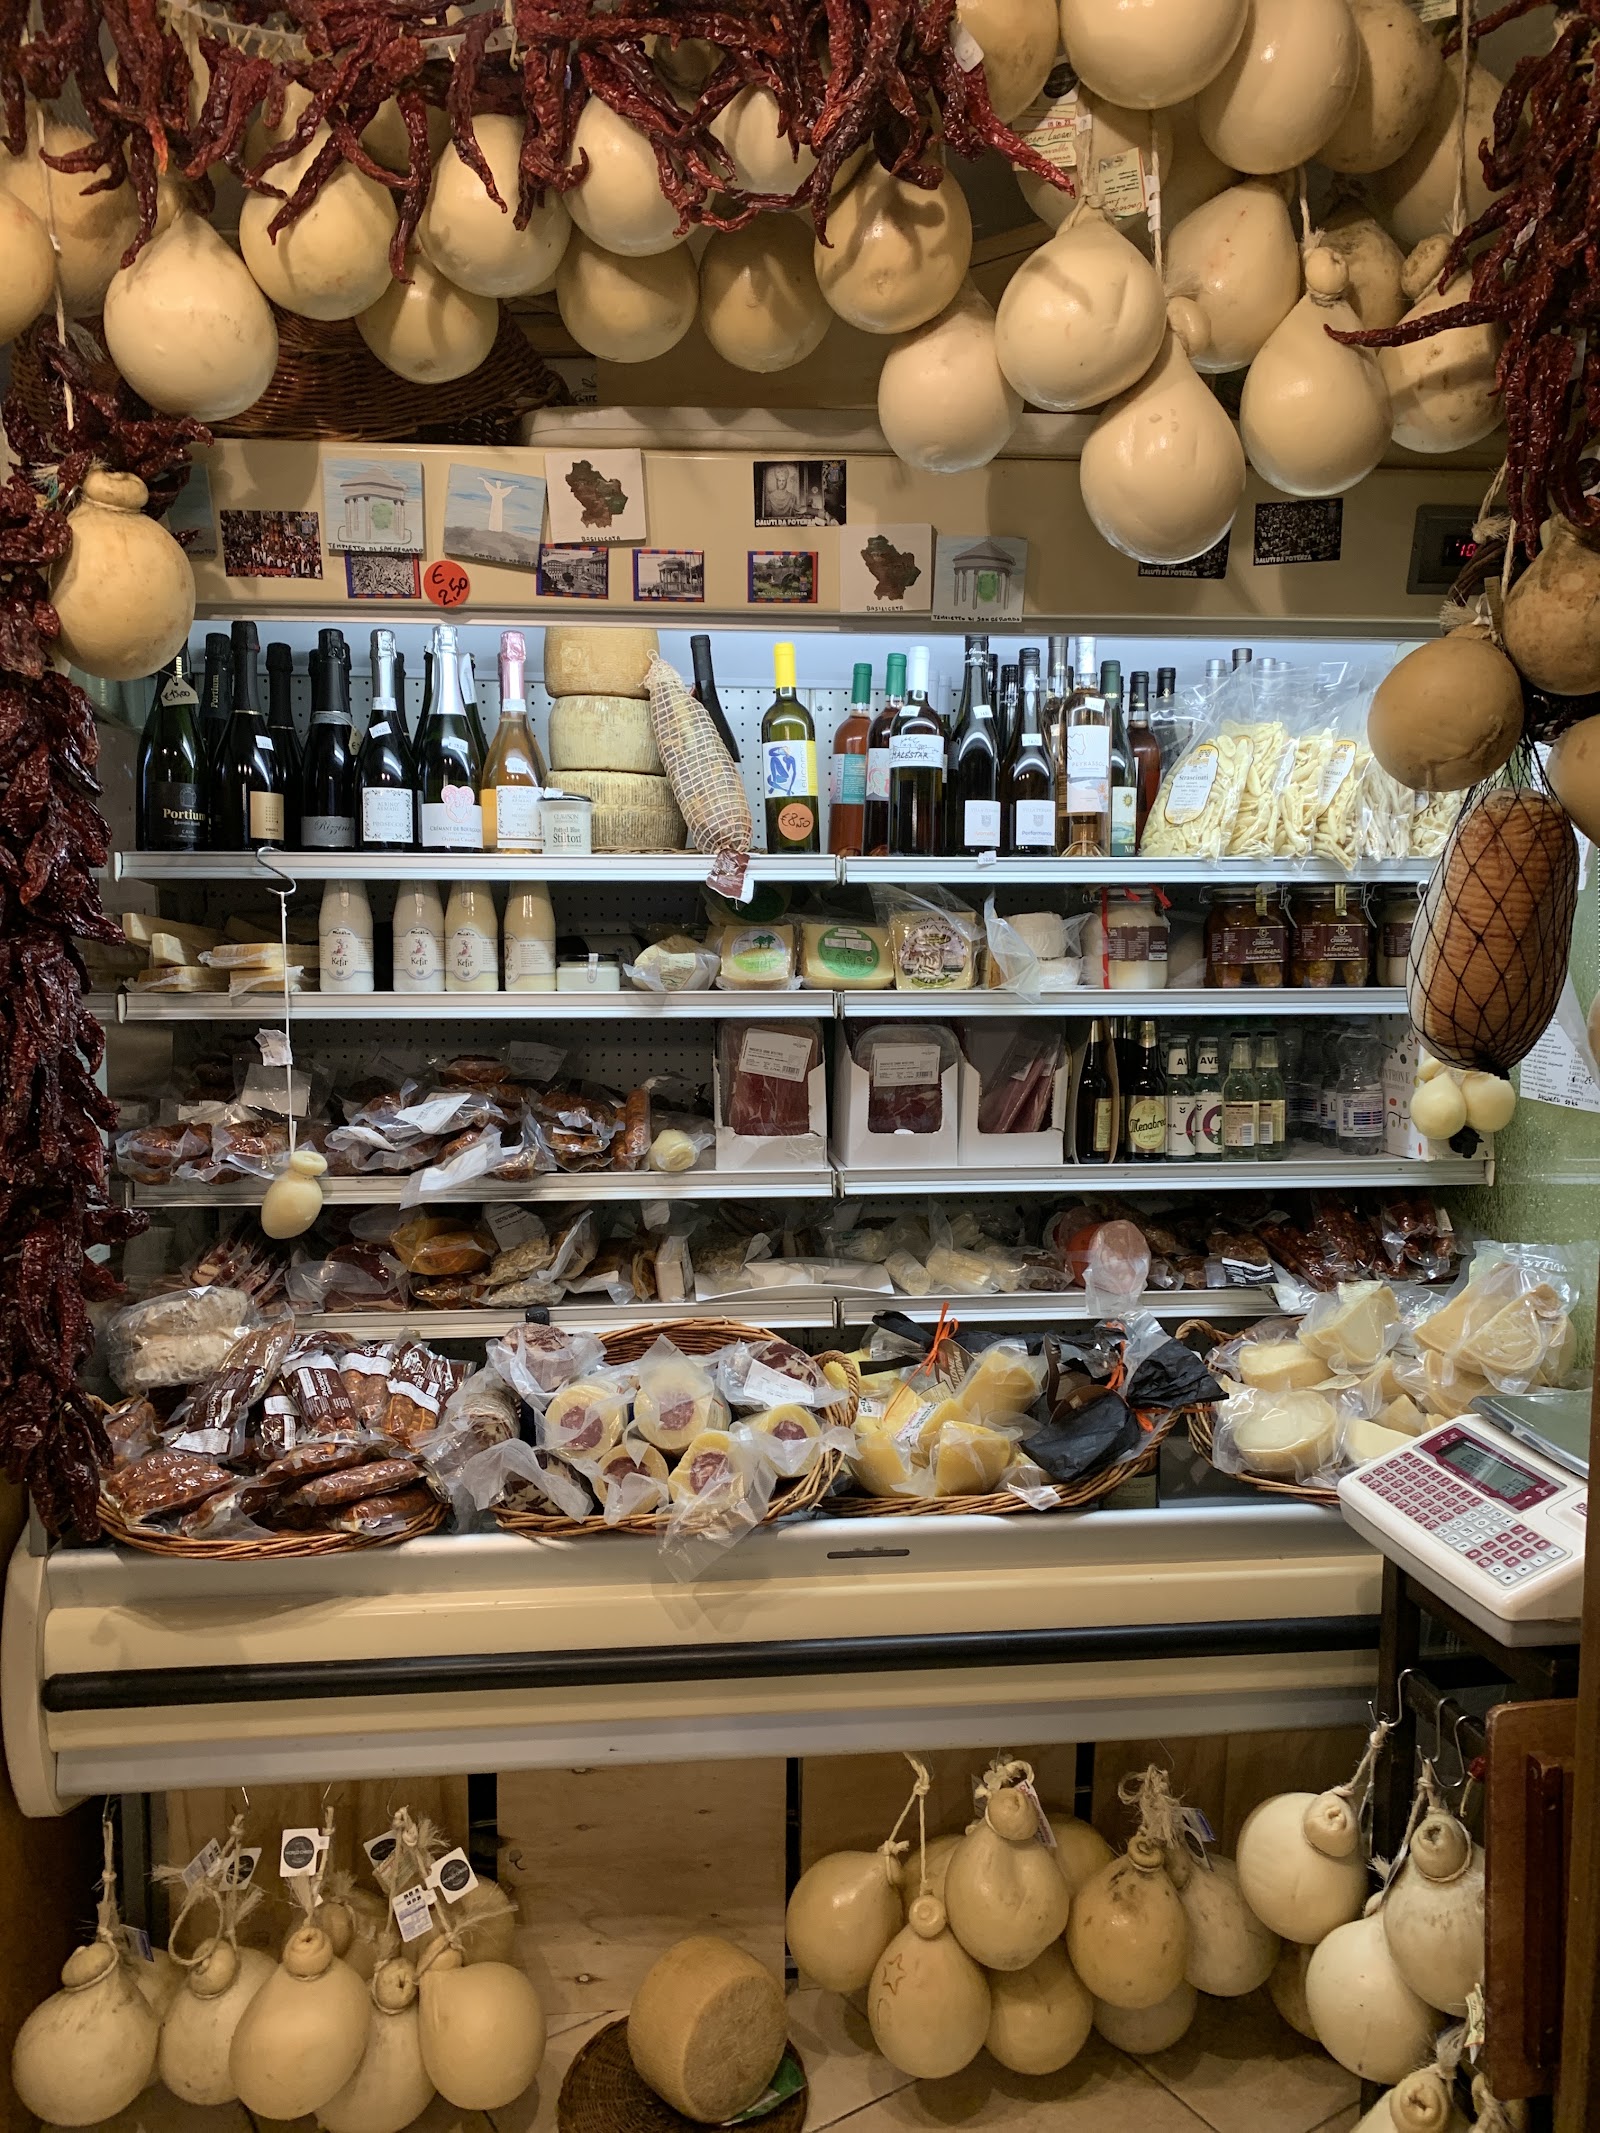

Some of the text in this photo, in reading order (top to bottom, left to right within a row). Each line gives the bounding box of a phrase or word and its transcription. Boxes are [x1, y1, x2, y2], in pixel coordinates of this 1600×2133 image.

[1255, 556, 1276, 564] SALUTI
[1285, 554, 1312, 562] POTENZA
[432, 564, 444, 584] €
[1140, 568, 1161, 576] SALUTI
[1170, 569, 1198, 577] POTENZA
[438, 577, 468, 606] 2,50
[211, 675, 220, 708] Portium
[892, 750, 929, 759] MALESTAR
[163, 808, 206, 820] Portium
[552, 833, 582, 844] Stilton
[332, 957, 348, 967] Kefir
[410, 957, 428, 967] Kefir
[457, 958, 474, 968] Kefir
